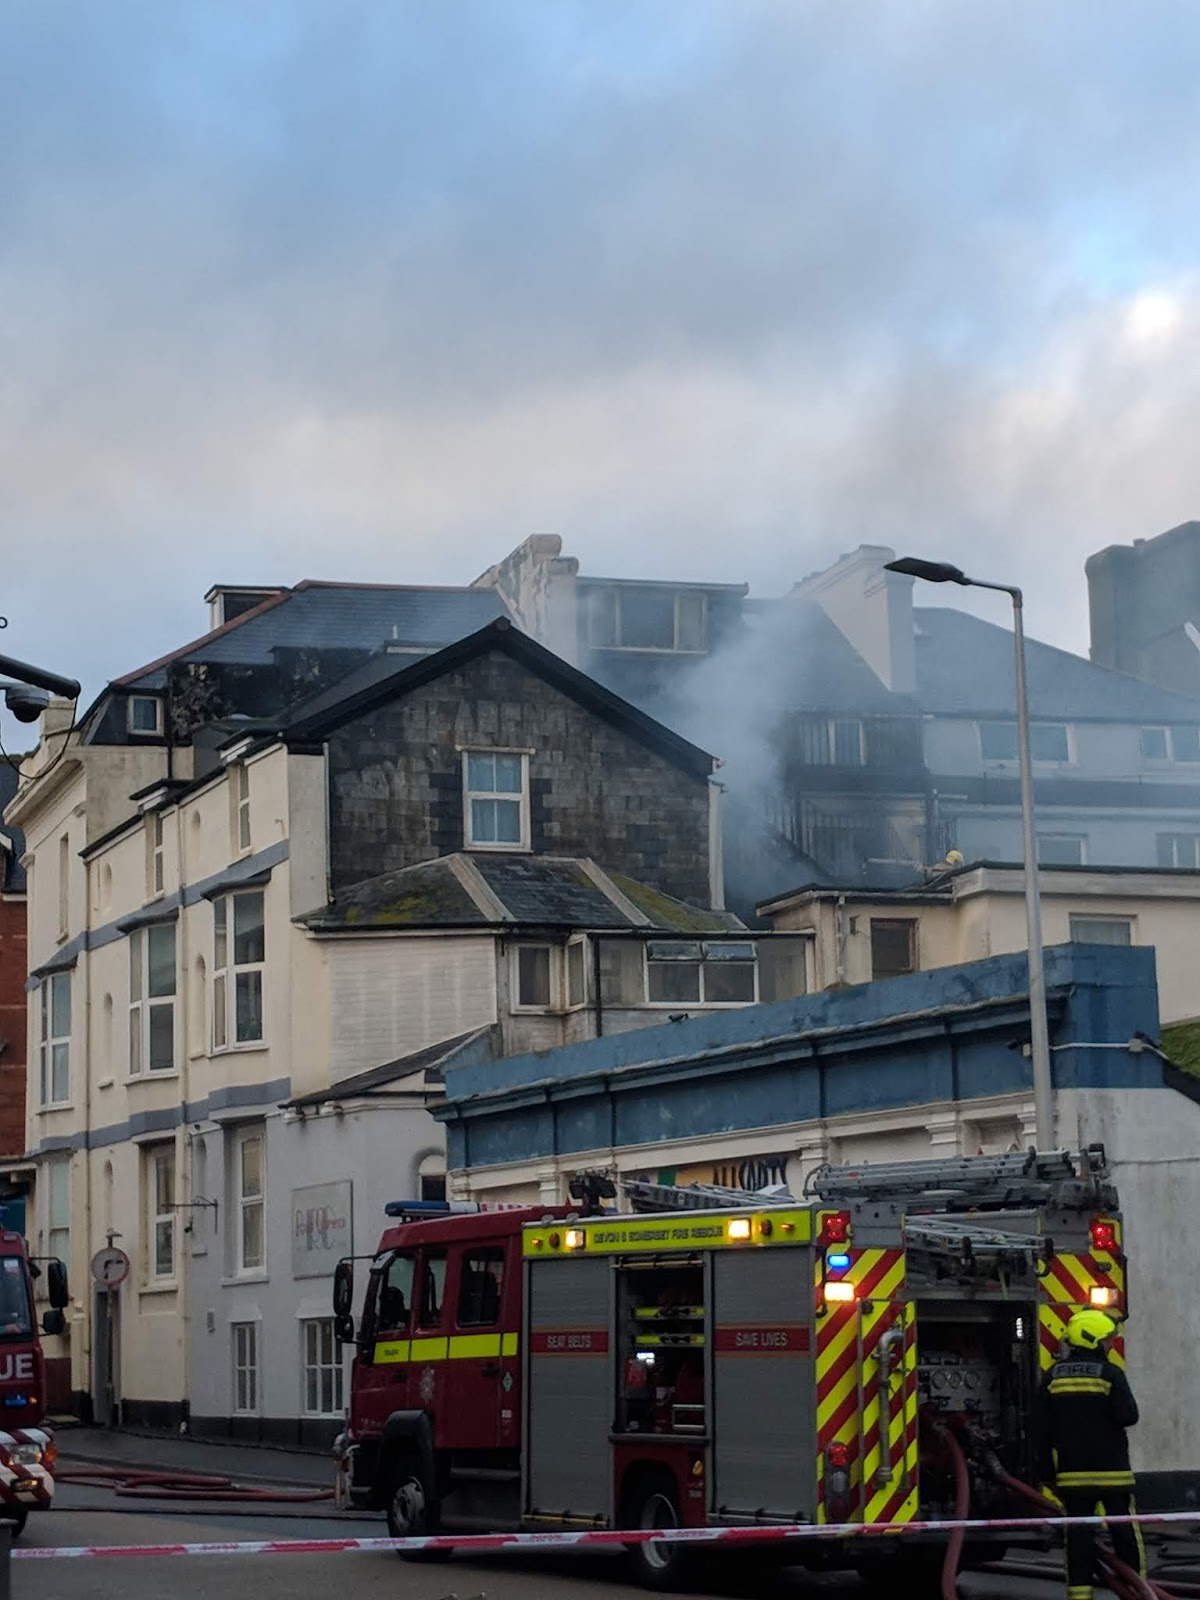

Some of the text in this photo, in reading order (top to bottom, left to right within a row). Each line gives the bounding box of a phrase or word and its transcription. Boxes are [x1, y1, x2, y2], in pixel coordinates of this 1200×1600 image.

[594, 1231, 620, 1244] DEVON
[628, 1229, 670, 1242] SOMERSET
[672, 1227, 690, 1239] FIRE
[691, 1225, 723, 1238] RESCUE
[547, 1334, 592, 1349] SEAT BELTS
[736, 1332, 788, 1347] SAVE LIVES
[1057, 1363, 1100, 1376] FIRE
